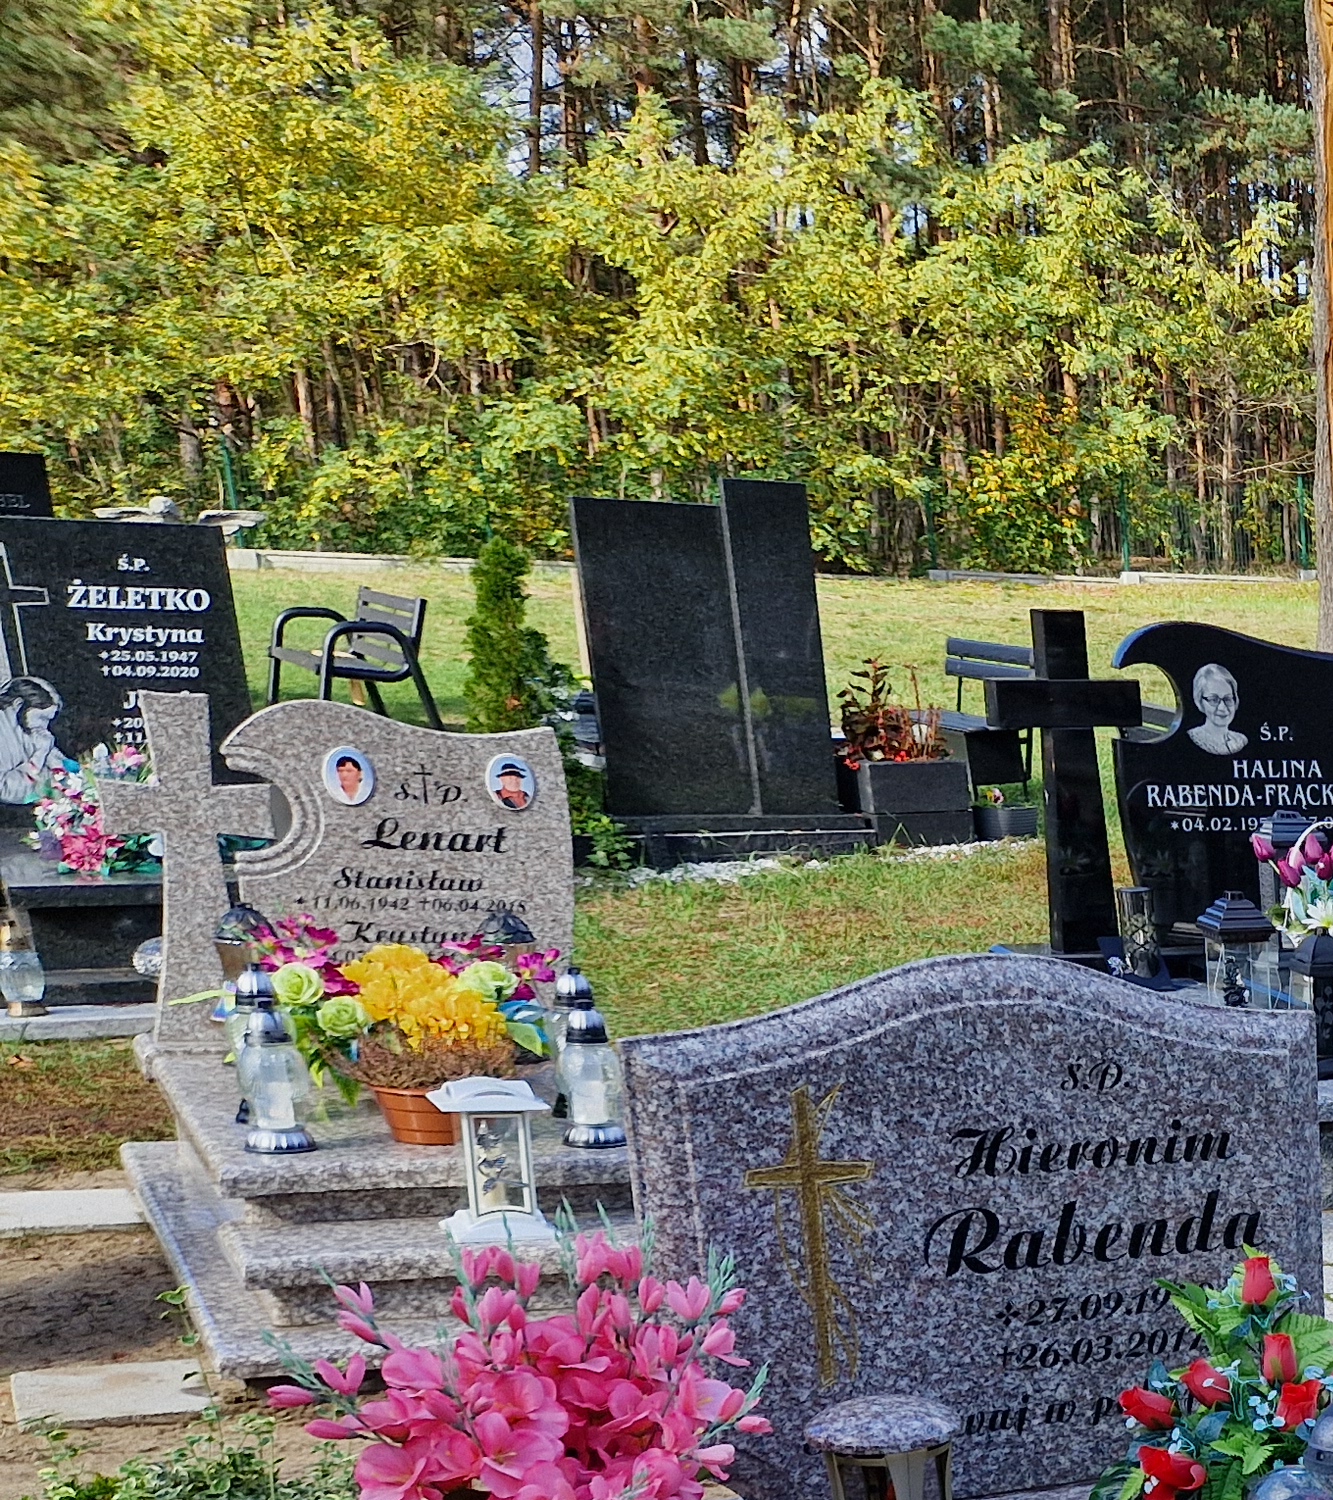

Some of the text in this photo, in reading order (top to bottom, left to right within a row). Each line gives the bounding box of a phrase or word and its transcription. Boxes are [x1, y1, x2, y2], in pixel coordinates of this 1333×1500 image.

[117, 554, 150, 571] Ś.P.
[67, 579, 210, 611] ŻELETKO
[85, 622, 204, 647] Krystyna
[109, 650, 198, 663] 25.05.1947
[112, 665, 200, 678] 04.09.2020
[1259, 721, 1294, 742] Ś.P.
[1232, 759, 1323, 779] HALINA
[360, 817, 508, 854] Lenart
[333, 866, 483, 892] Stanisław
[341, 920, 467, 944] Krystyn
[949, 1118, 1235, 1180] Hieronim
[923, 1188, 1267, 1278] Rabenda
